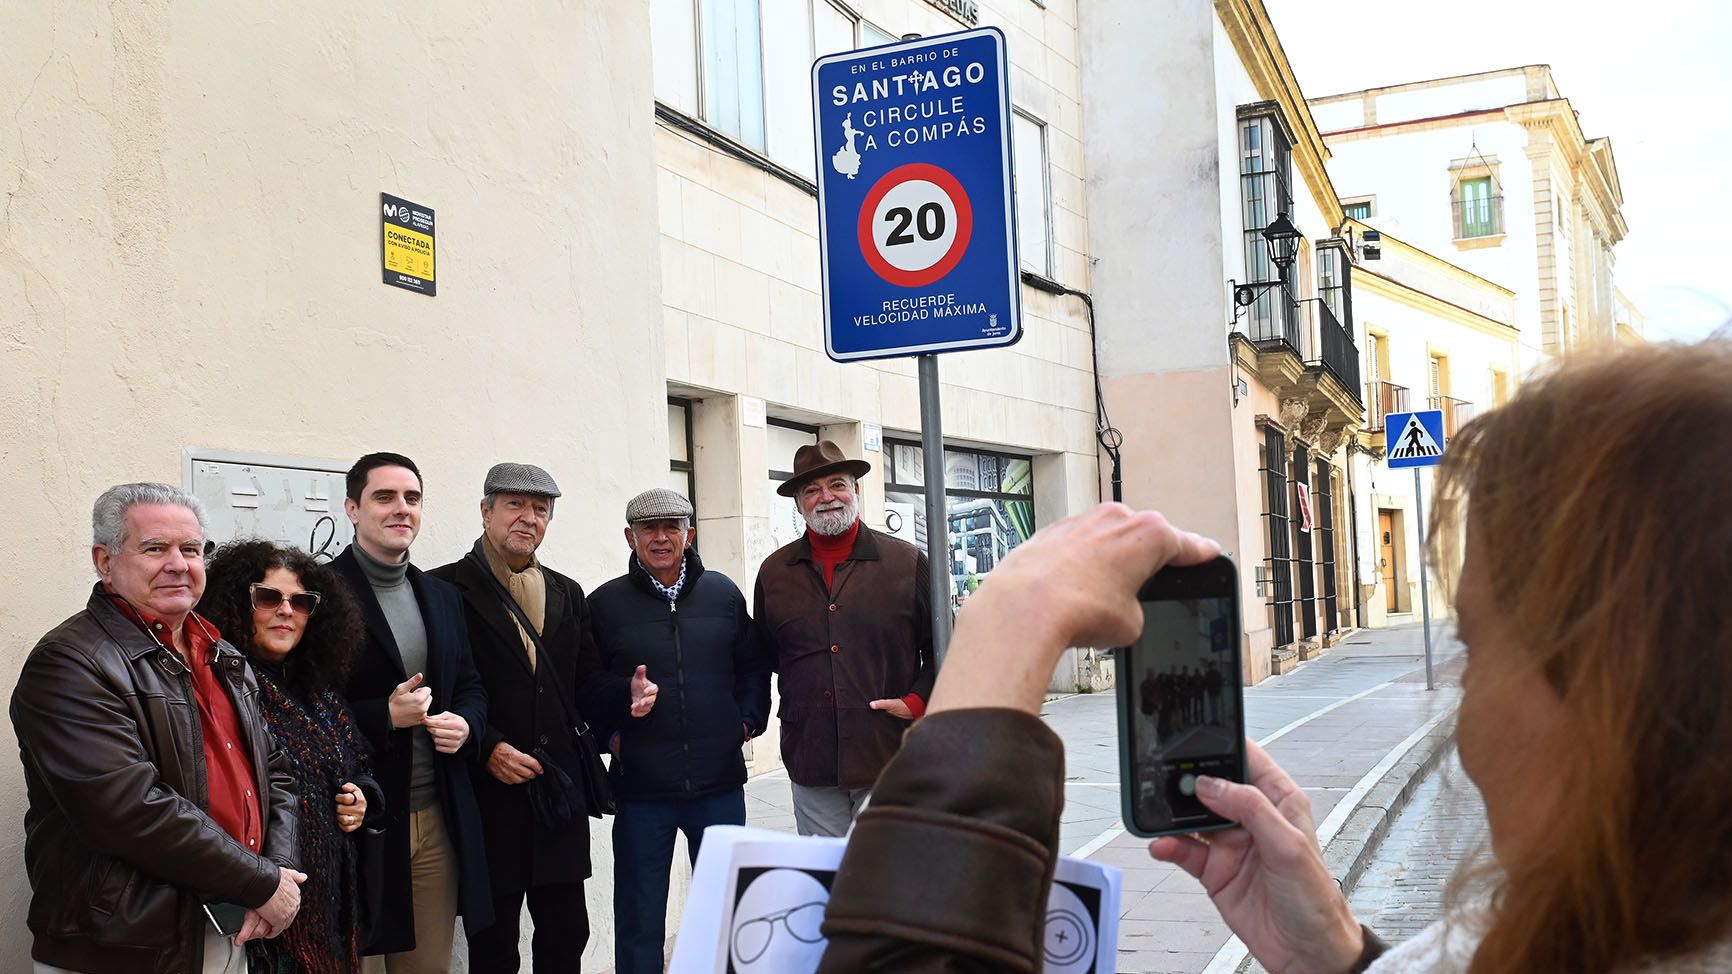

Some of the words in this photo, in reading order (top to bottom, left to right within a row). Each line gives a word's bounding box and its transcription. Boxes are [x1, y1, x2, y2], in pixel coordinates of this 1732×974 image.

[851, 65, 866, 74] EN
[872, 61, 886, 70] EL
[891, 53, 937, 68] BARRIO
[943, 47, 959, 58] DE
[863, 96, 964, 128] CIRCULE
[865, 134, 878, 151] A
[887, 115, 986, 147] COMPÁS
[885, 202, 946, 247] 20
[387, 230, 430, 250] CONECTADA
[387, 239, 398, 247] CON
[853, 308, 929, 327] VELOCIDAD
[933, 302, 987, 318] MÁXIMA
[882, 293, 955, 312] RECUERDE
